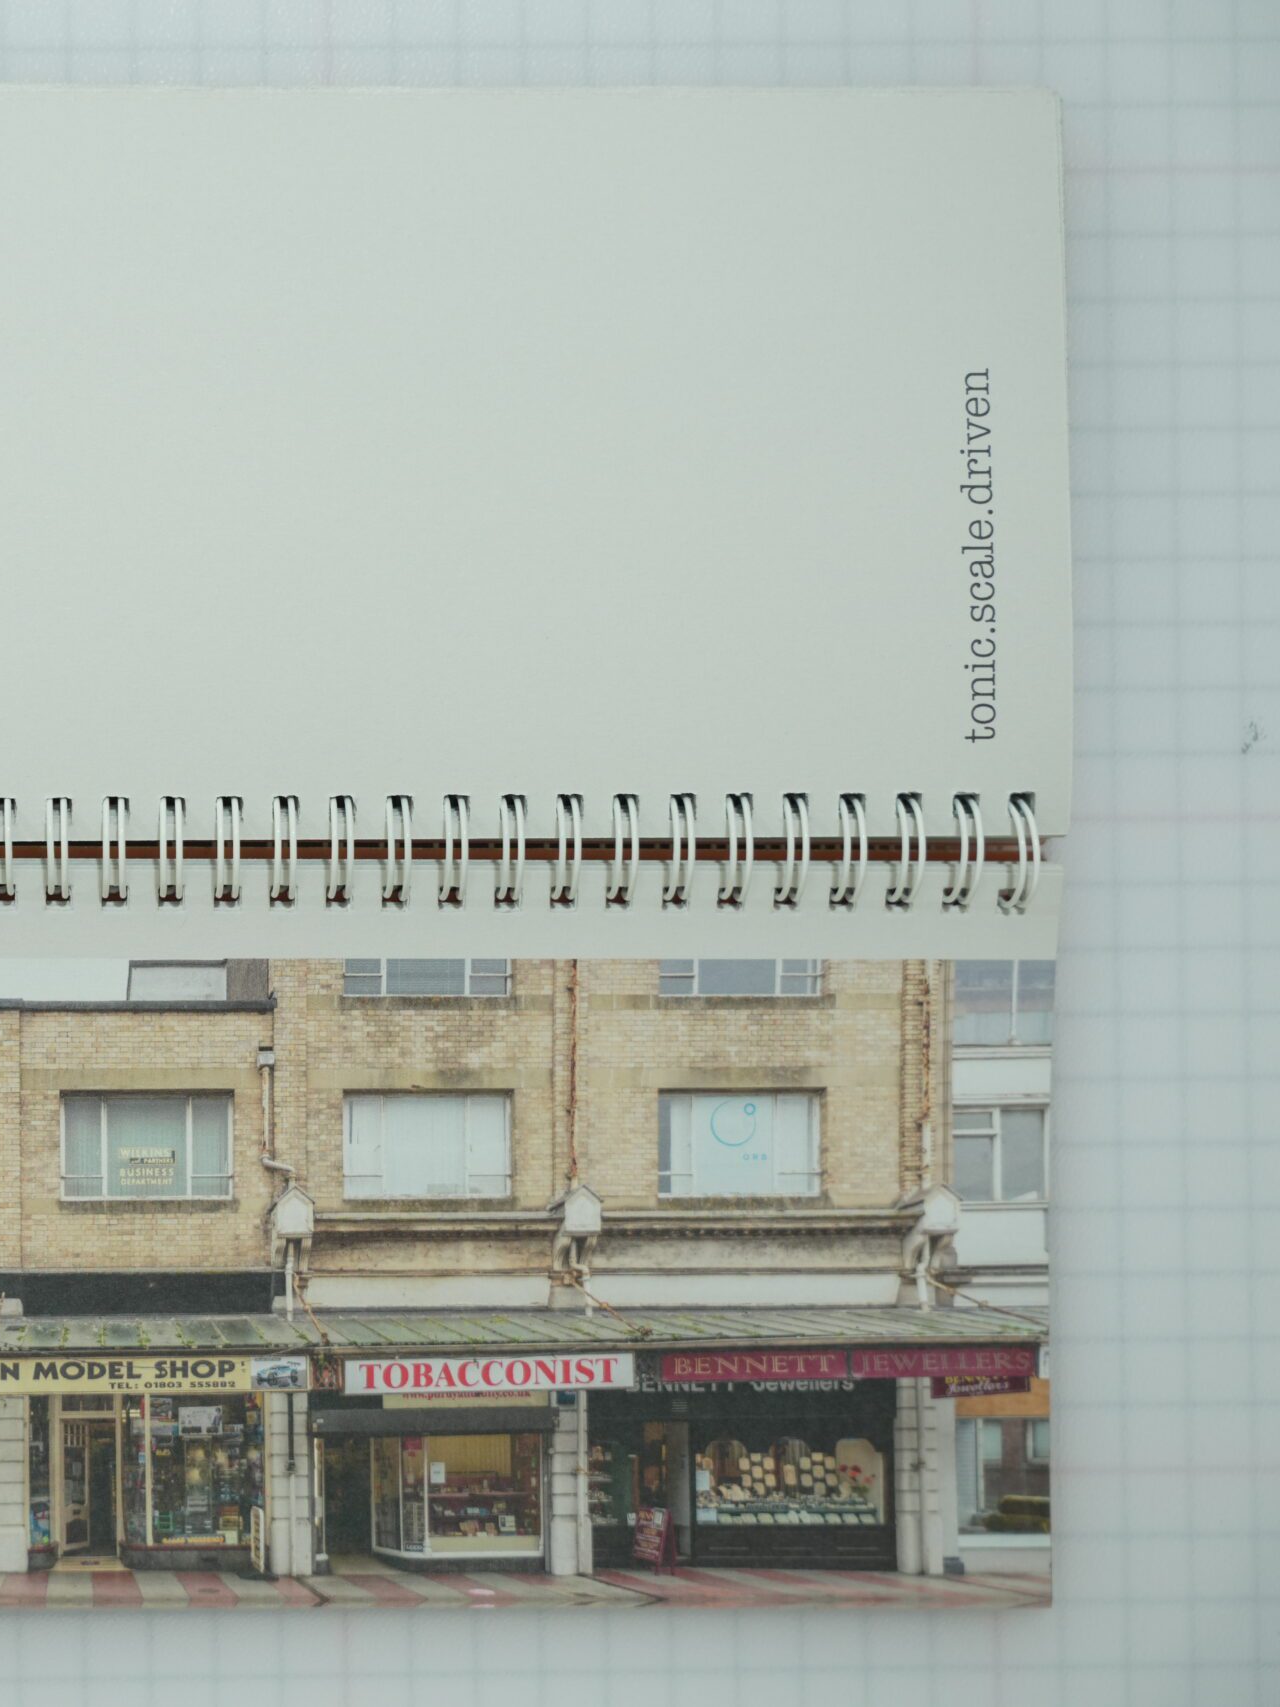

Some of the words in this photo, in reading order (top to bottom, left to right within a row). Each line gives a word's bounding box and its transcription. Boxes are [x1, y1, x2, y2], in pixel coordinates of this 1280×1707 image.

[959, 367, 997, 743] tonic.scale.driven
[120, 1147, 172, 1158] WILKINS
[120, 1168, 175, 1177] BUSINESS
[33, 1360, 142, 1380] MODEL
[155, 1360, 235, 1379] SHOP
[674, 1354, 836, 1375] BENNETT
[861, 1351, 1032, 1372] JEWELLERS
[359, 1358, 618, 1389] TOBACCONIST
[109, 1381, 139, 1389] TEL:
[144, 1381, 183, 1389] 01803
